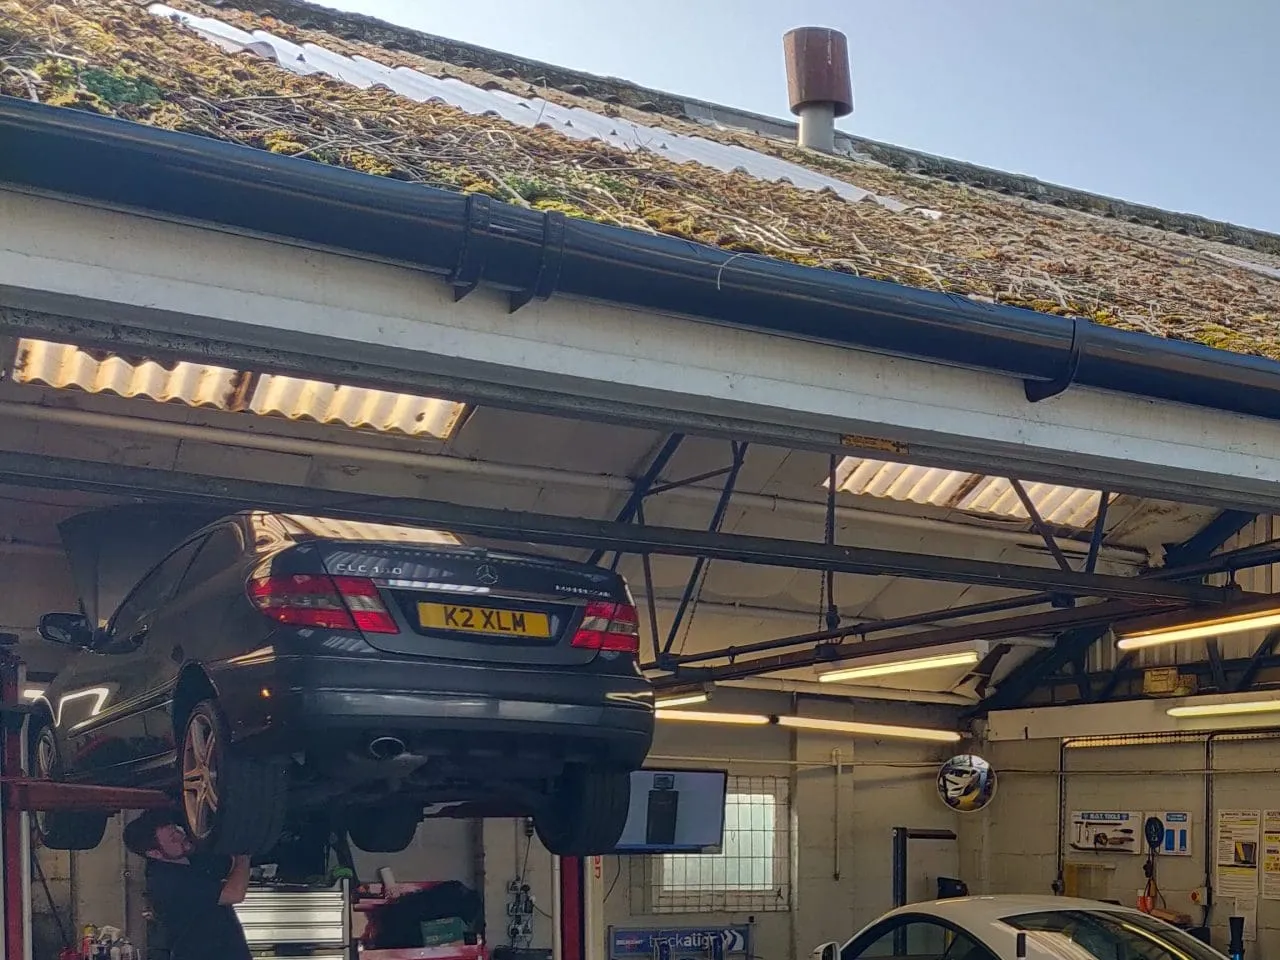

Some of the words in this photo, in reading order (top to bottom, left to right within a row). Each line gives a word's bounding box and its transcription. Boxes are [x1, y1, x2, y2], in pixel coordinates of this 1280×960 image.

[336, 563, 367, 573] CLC
[373, 565, 402, 575] 10
[444, 606, 474, 628] K2
[479, 610, 526, 632] XLM
